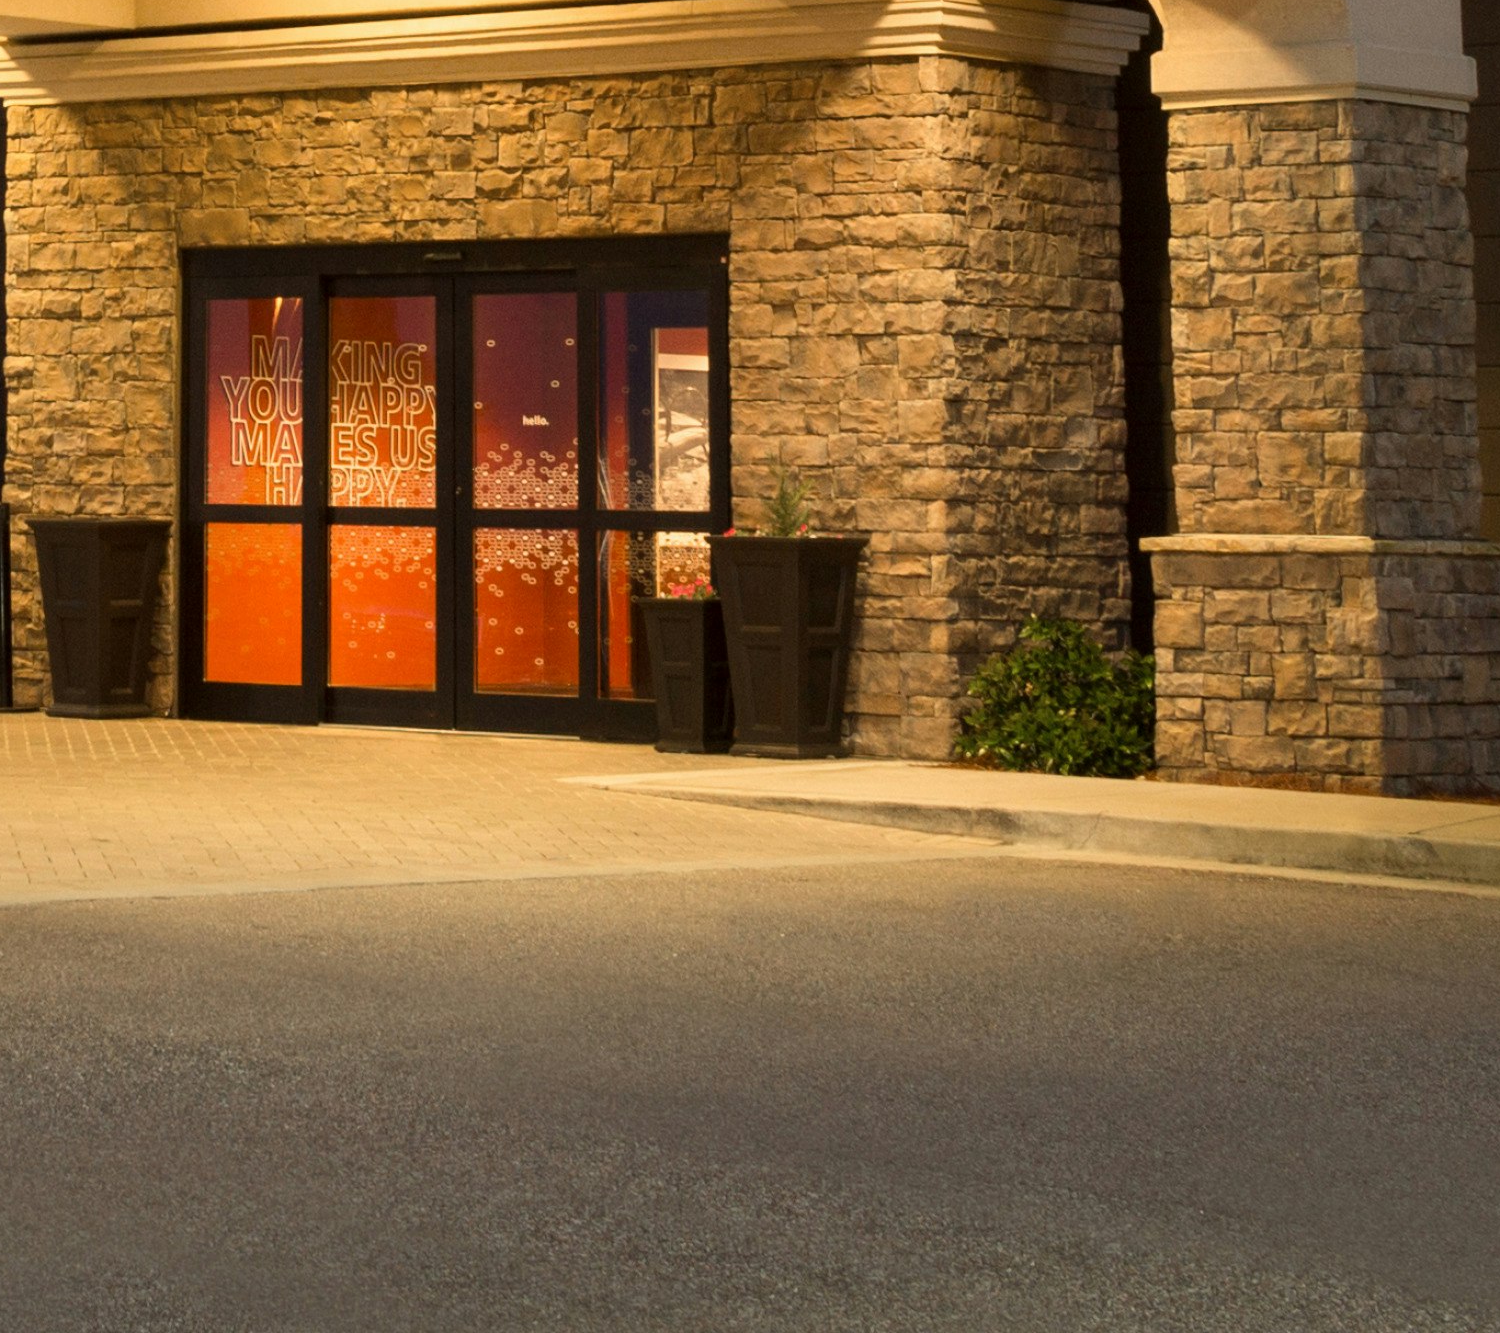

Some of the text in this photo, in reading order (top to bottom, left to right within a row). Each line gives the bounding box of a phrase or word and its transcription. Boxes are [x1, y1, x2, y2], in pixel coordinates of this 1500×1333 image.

[221, 376, 303, 425] YOU
[522, 414, 549, 426] hello.
[231, 419, 437, 472] MAES US
